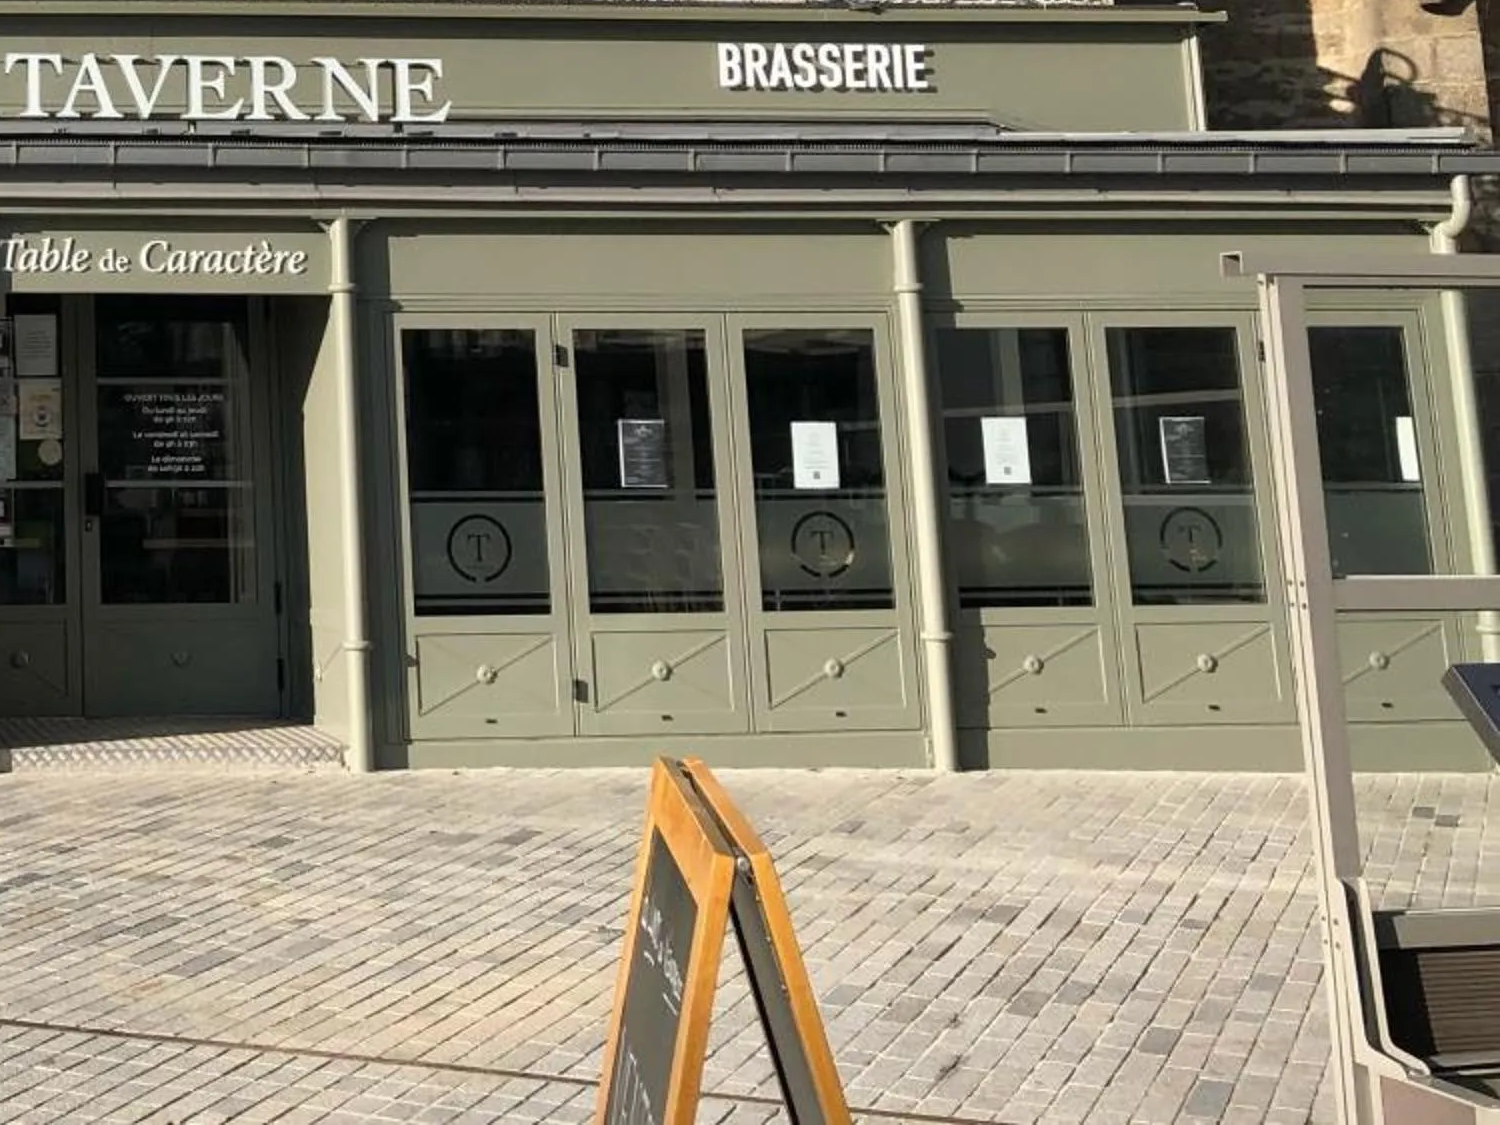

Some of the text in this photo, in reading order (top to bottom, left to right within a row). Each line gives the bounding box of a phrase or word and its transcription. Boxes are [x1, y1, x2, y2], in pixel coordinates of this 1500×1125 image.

[717, 41, 930, 89] BRASSERIE
[4, 52, 452, 123] TAVERNE
[0, 236, 308, 275] Table de Caractère
[467, 534, 491, 563] T
